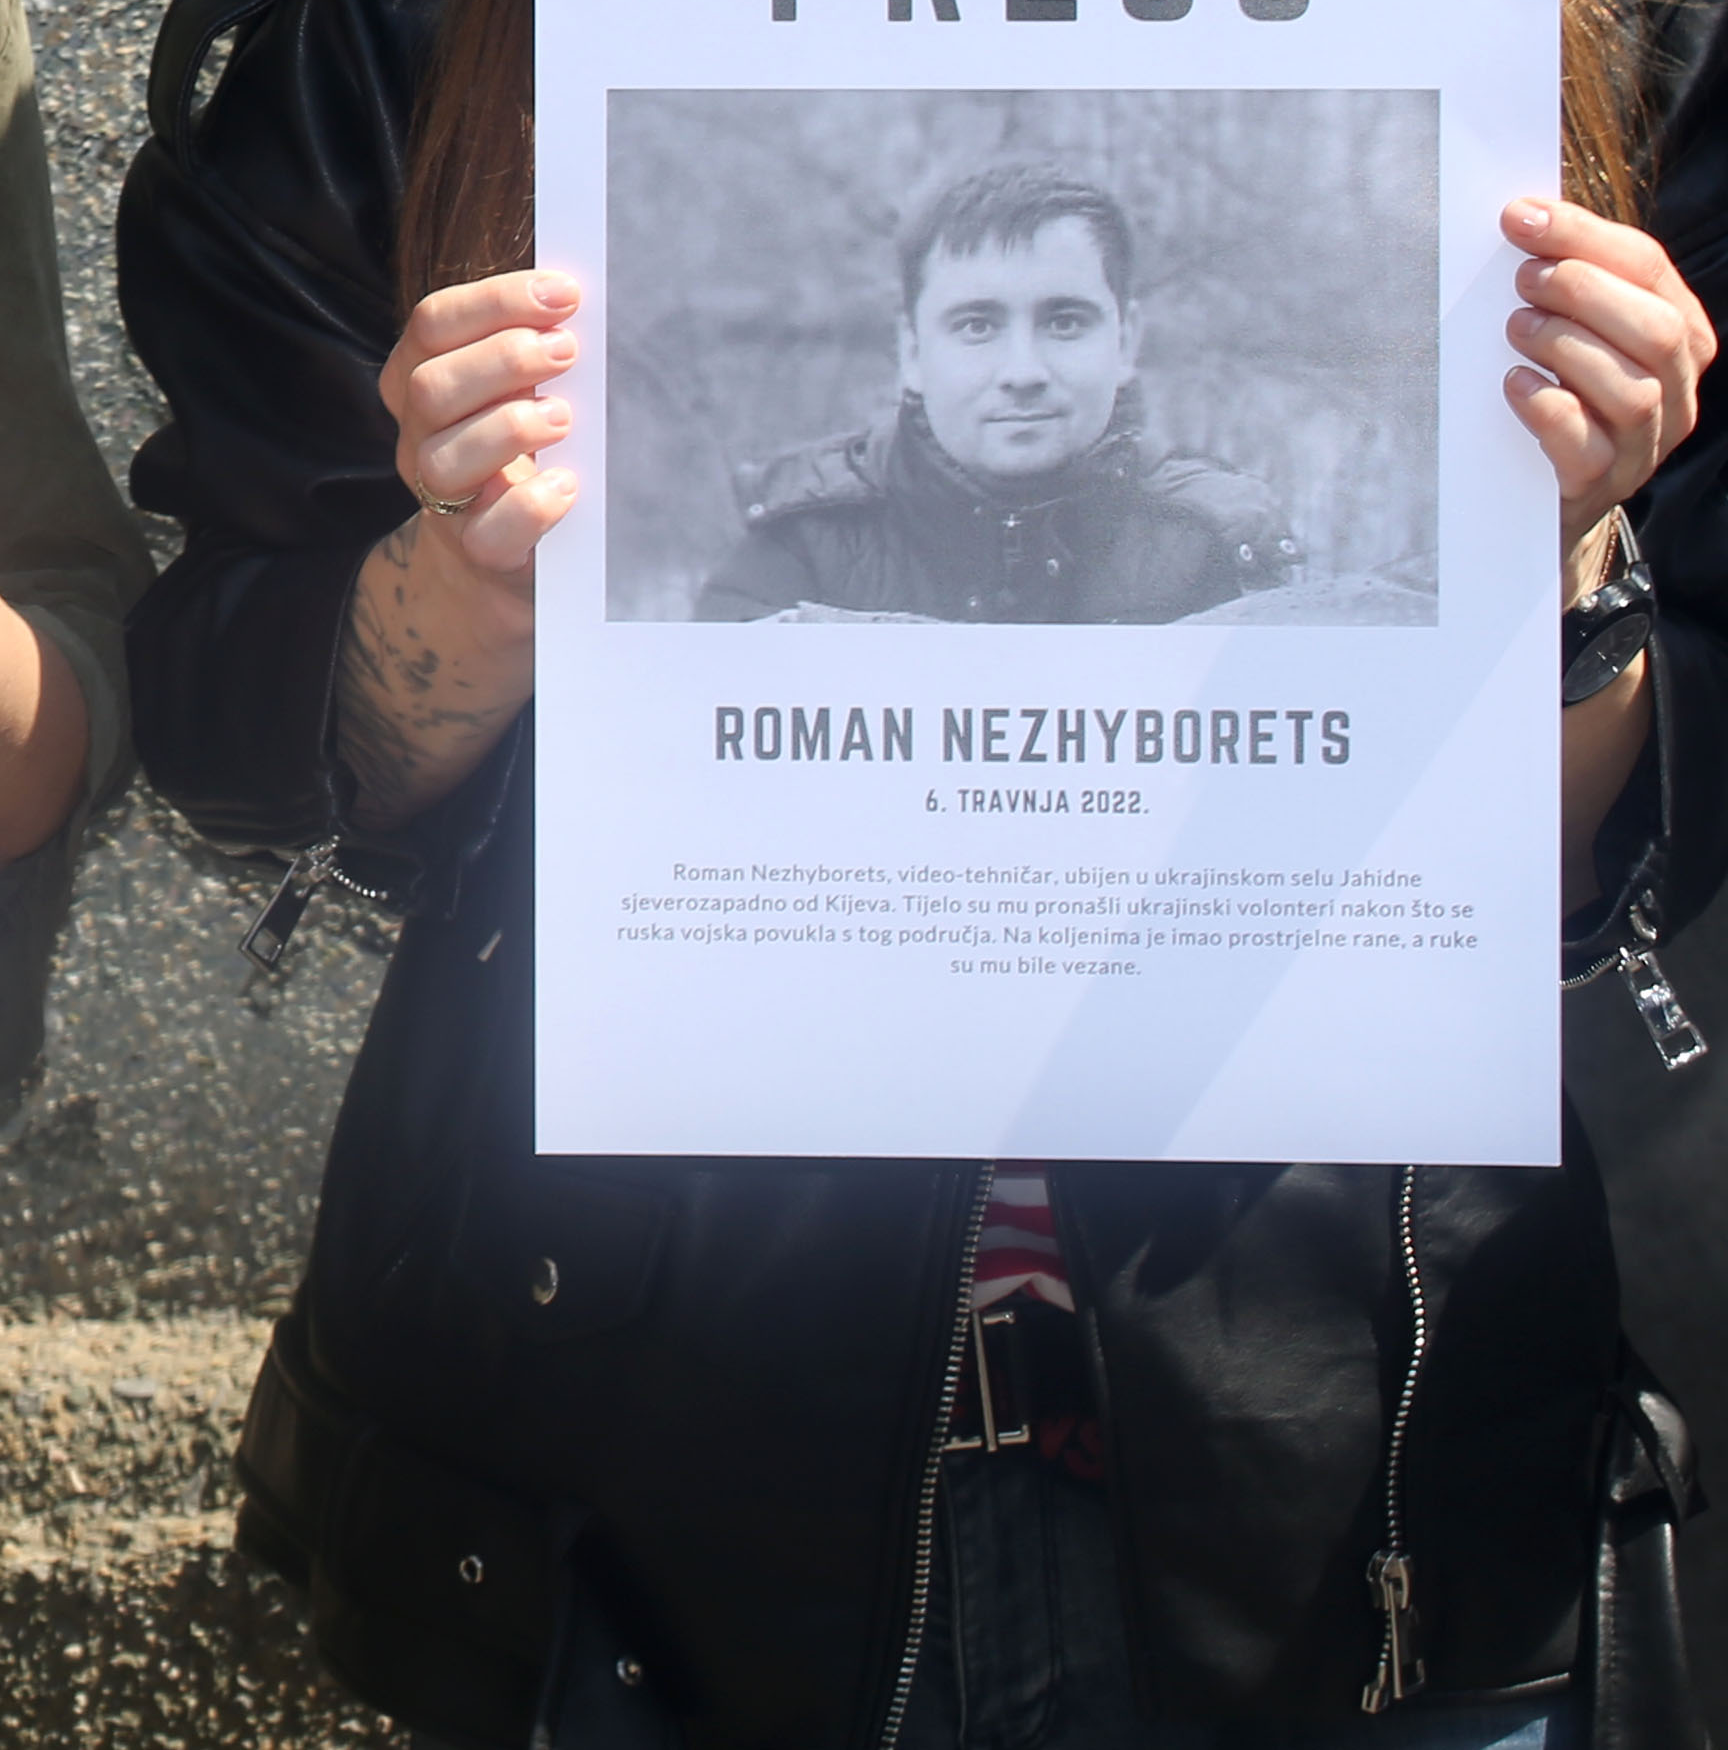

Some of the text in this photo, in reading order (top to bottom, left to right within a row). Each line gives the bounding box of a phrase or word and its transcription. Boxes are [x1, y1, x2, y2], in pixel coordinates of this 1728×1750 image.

[715, 705, 1351, 766] ROMAN NEZHYBORETS
[925, 788, 1150, 815] 6. TRAVNJA 2022.
[673, 862, 1423, 890] Roman Nezhyborets, video-tehničar, ubijen u ukrajinskom selu Jahidne
[621, 892, 1475, 920] sjeverozapadno od Kijeva. Tijelo su mu pronašli ukrajinski volonteri nakon što se
[617, 922, 1479, 951] ruska vojska povukla s tog područja. Na koljenima je imao prostrjelne rane, a ruke
[950, 955, 1142, 976] su mu bile vezane.
